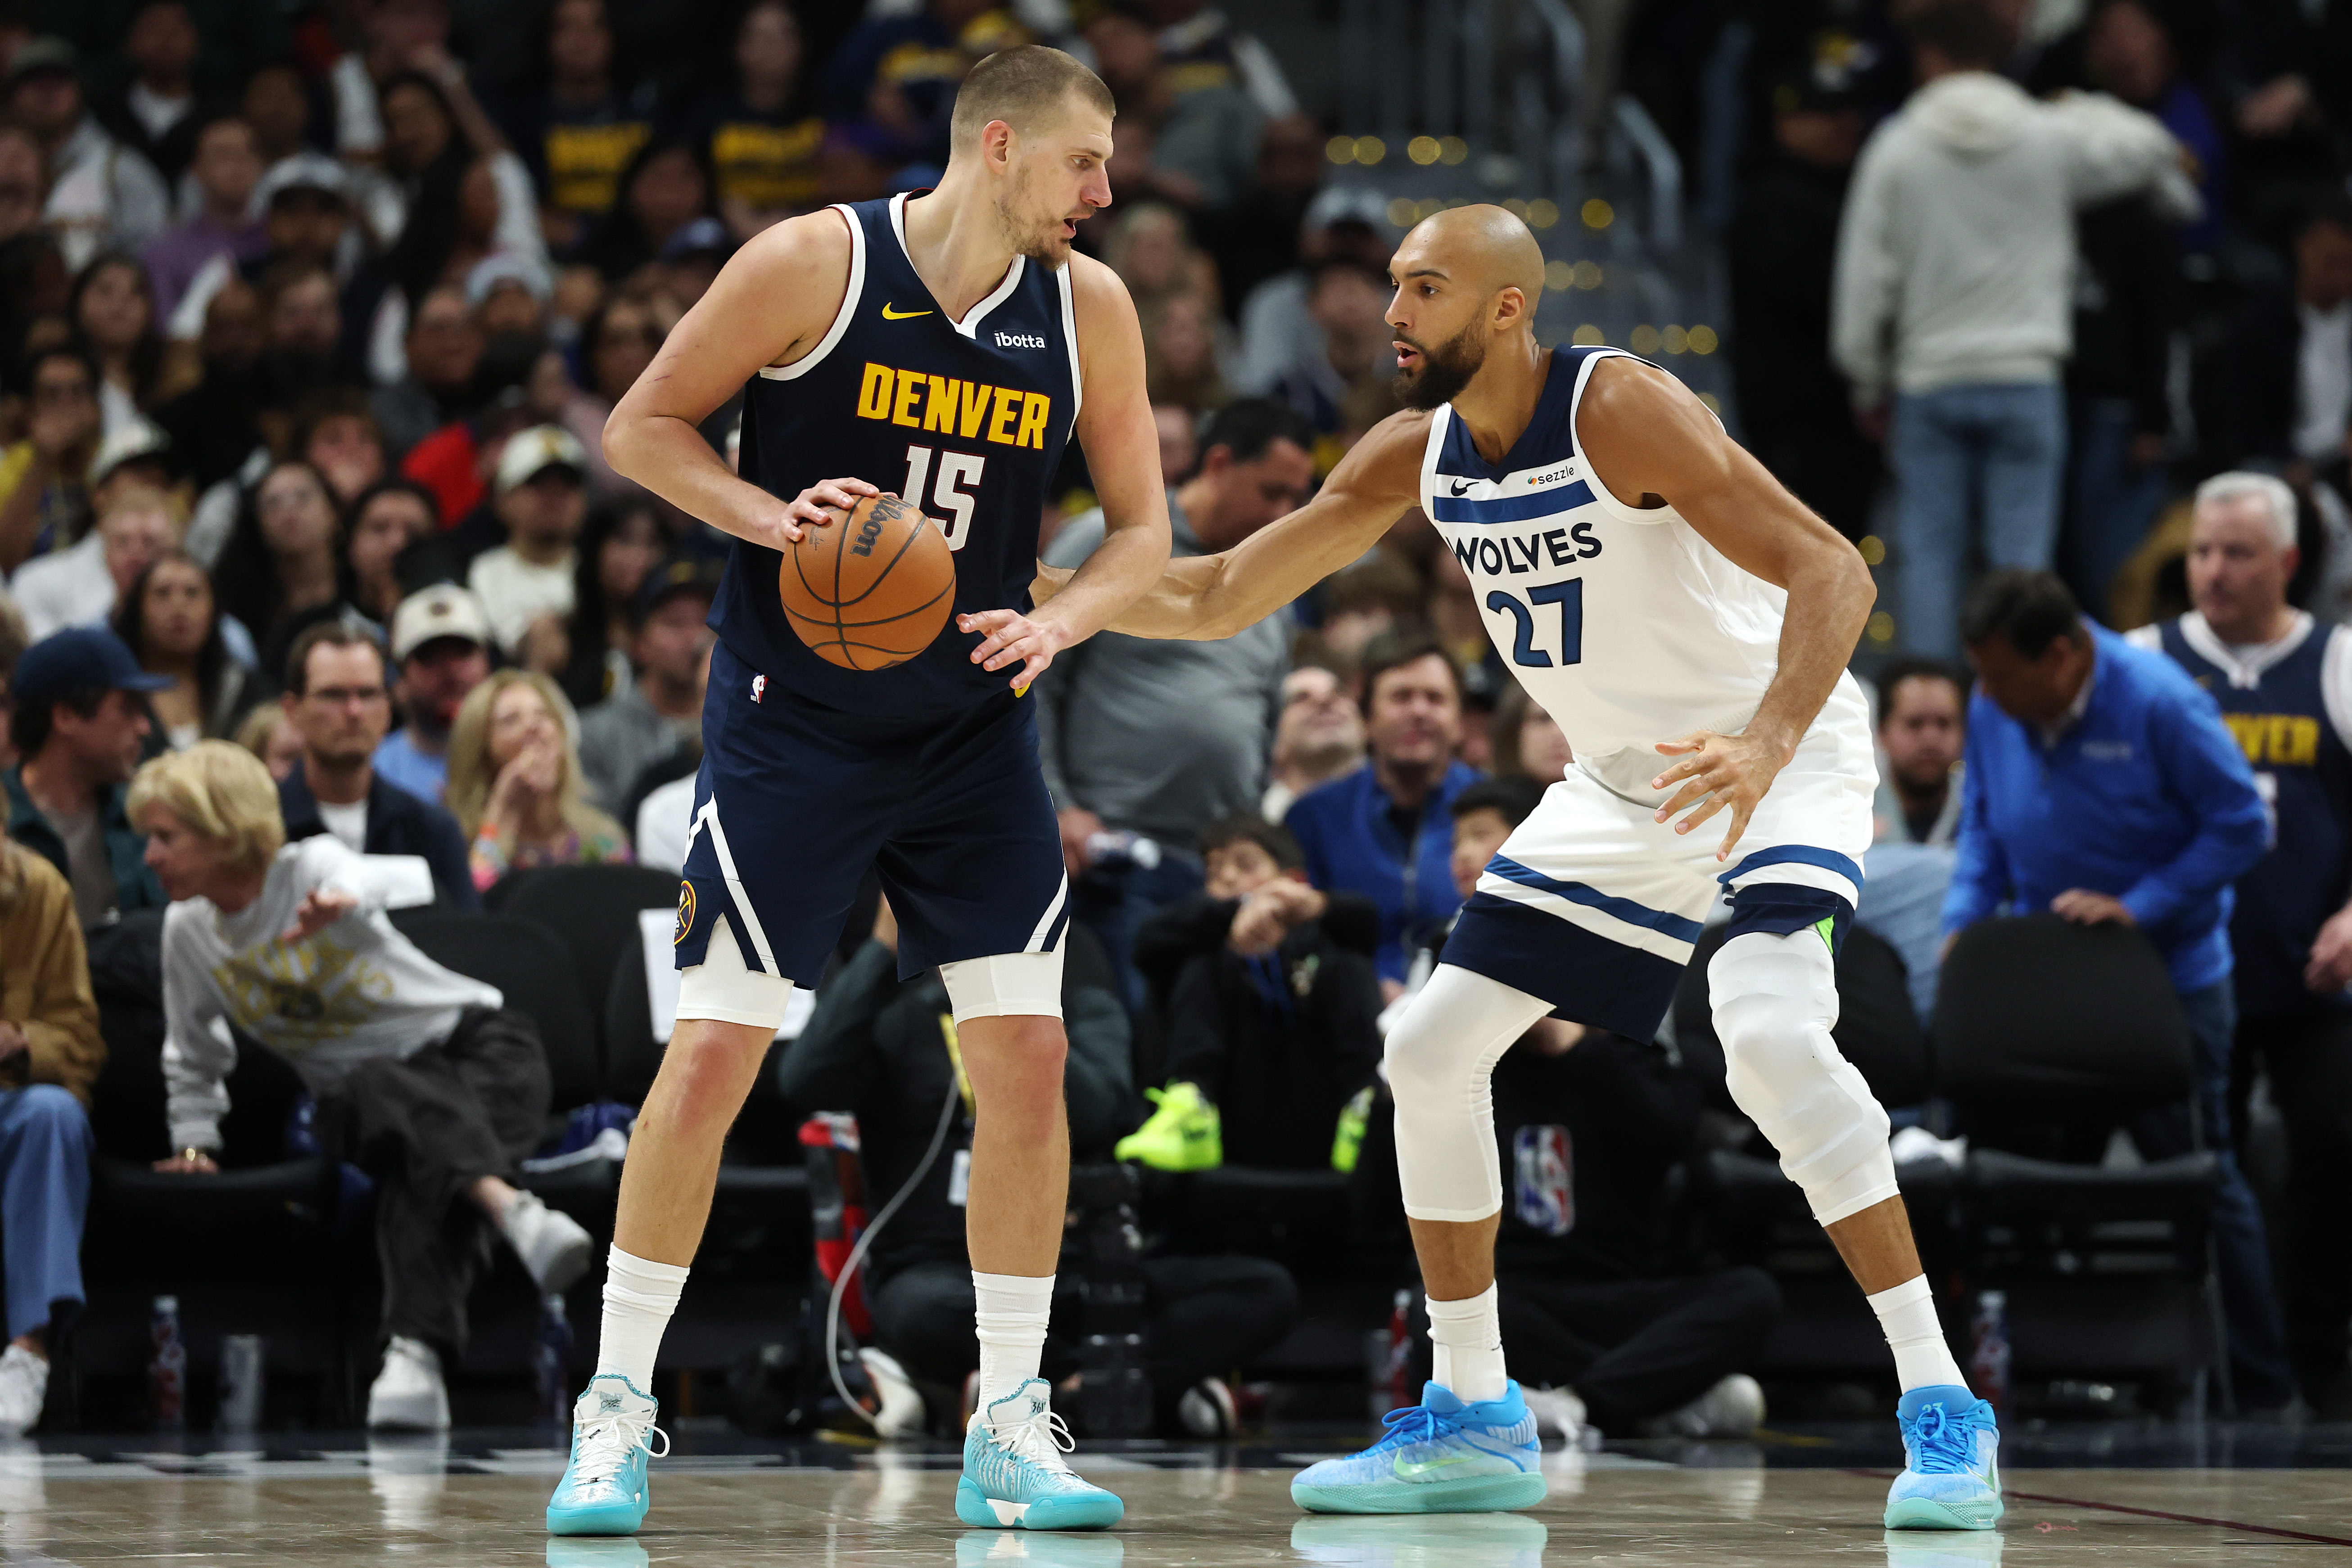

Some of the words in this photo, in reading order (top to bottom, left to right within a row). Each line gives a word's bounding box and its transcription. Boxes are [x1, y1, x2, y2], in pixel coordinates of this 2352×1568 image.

[994, 332, 1045, 348] ibotta
[856, 361, 1051, 450] DENVER
[902, 443, 987, 553] 15
[1538, 465, 1574, 484] sezzle
[1445, 523, 1602, 575] WOLVES
[1487, 577, 1583, 667] 27
